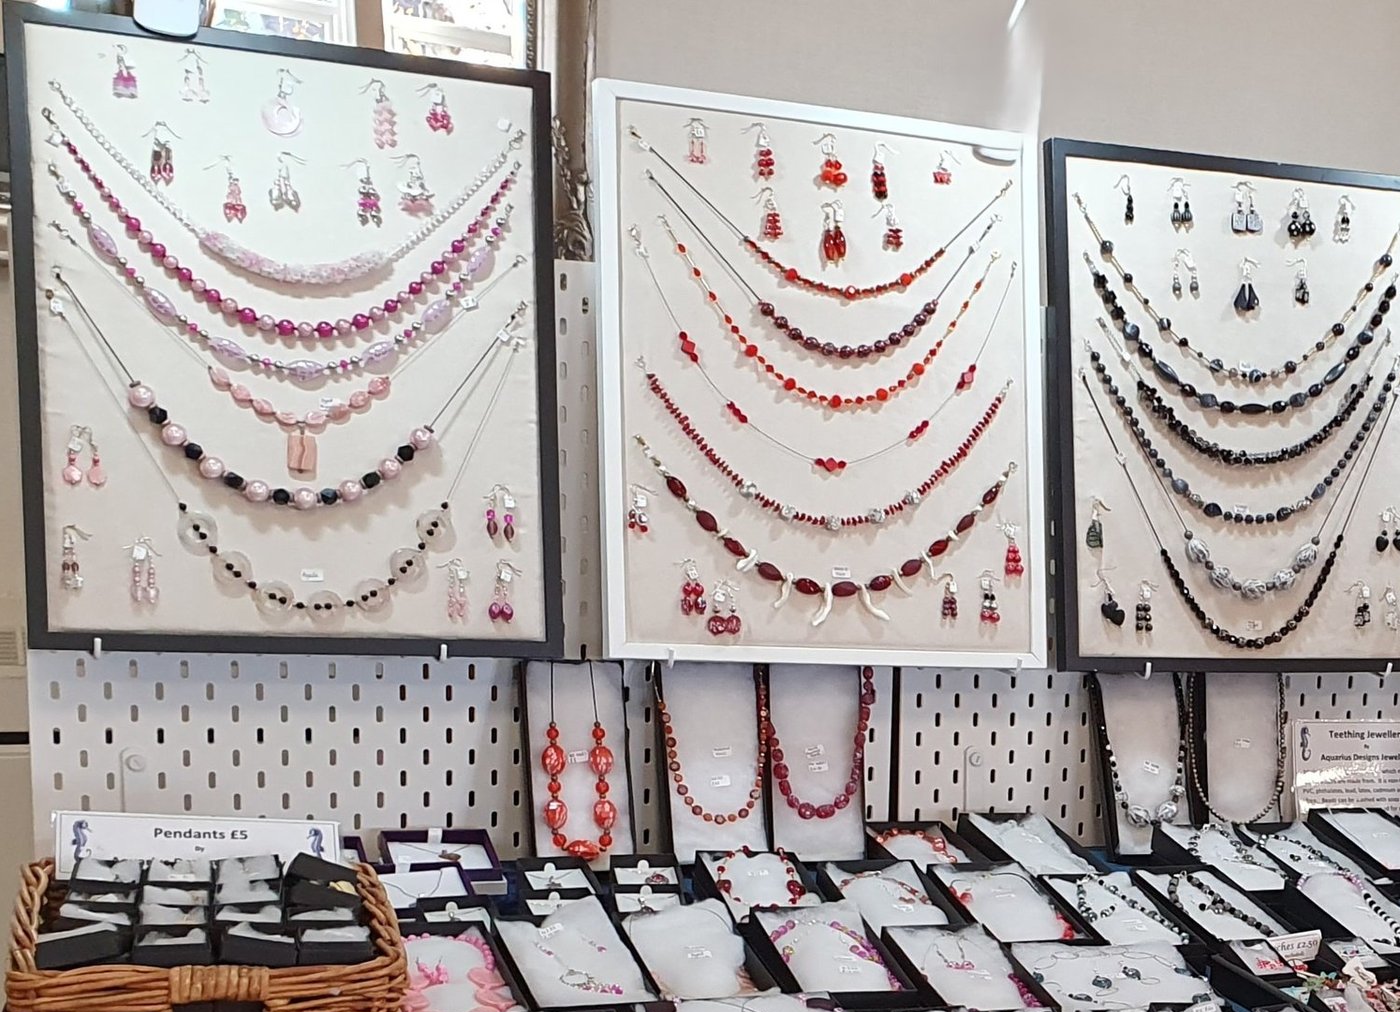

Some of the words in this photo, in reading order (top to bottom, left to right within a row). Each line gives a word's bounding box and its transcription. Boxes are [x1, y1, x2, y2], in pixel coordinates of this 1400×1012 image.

[1329, 730, 1365, 740] Teething
[1353, 754, 1380, 762] Designs
[154, 828, 226, 840] Pendants
[231, 830, 248, 840] £5
